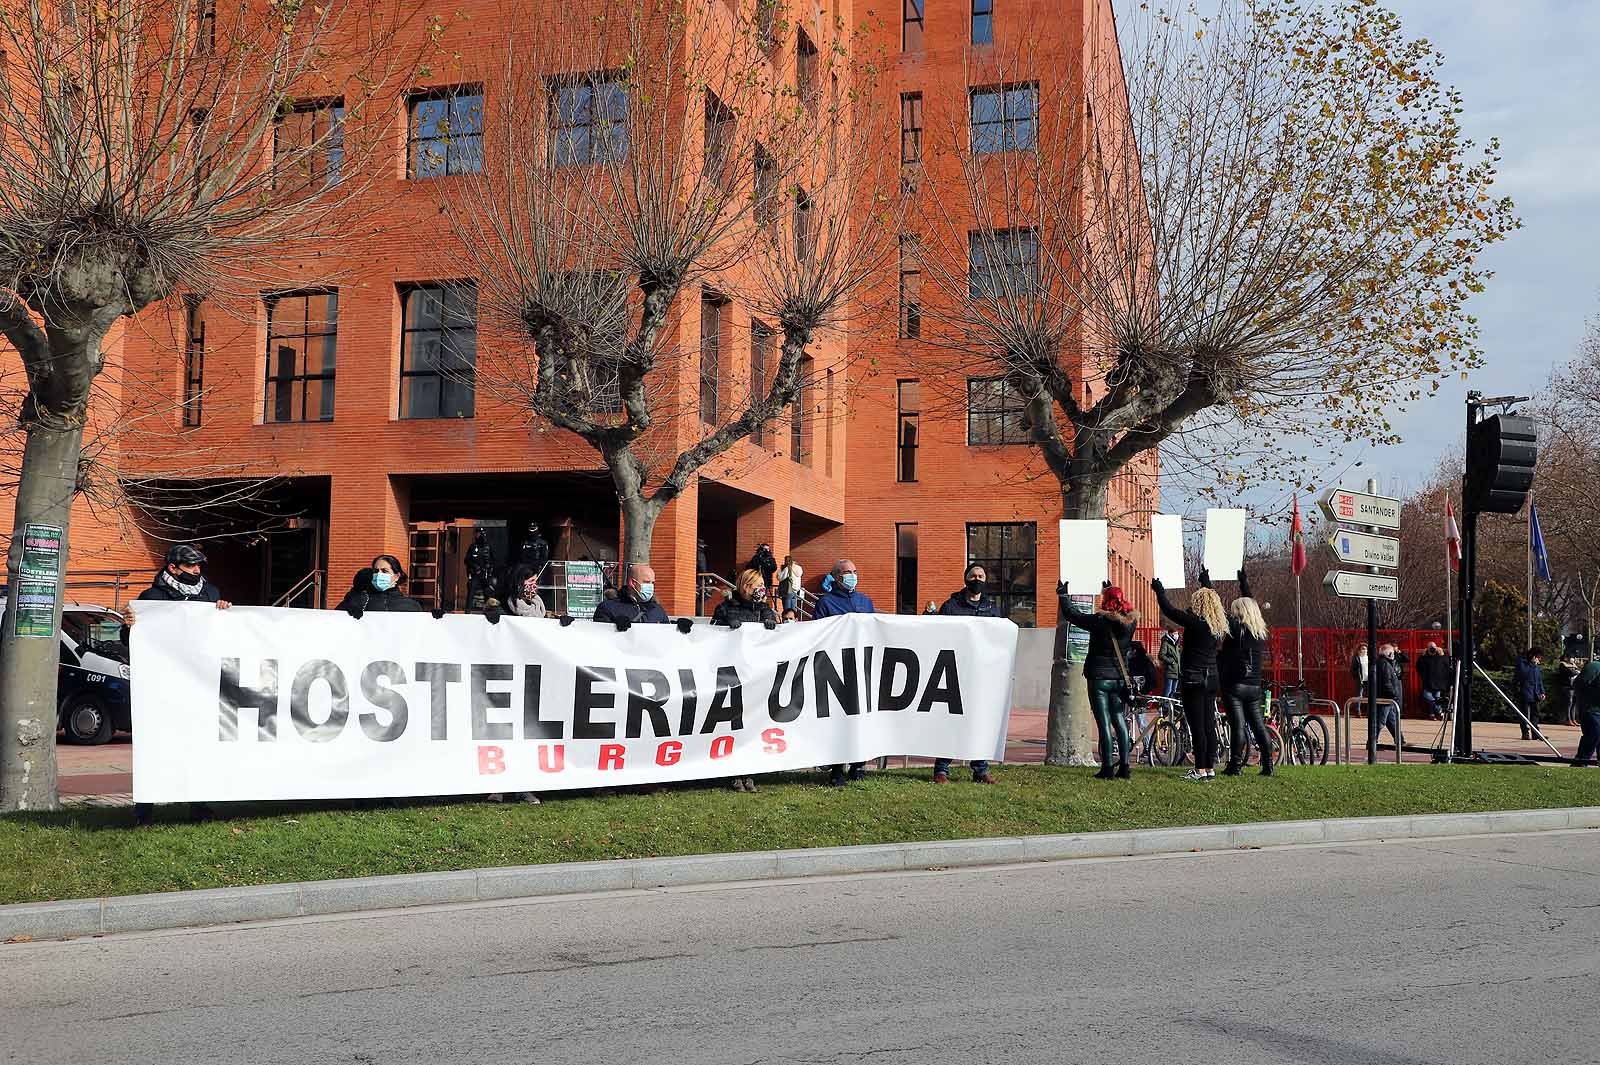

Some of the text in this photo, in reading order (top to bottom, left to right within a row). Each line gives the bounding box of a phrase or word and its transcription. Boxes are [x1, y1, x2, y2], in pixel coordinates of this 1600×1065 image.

[1360, 504, 1396, 518] SANTANDER
[1368, 583, 1394, 593] cementerio
[218, 645, 964, 743] HOSTELERIA UNIDA
[477, 727, 789, 776] BURGOS
